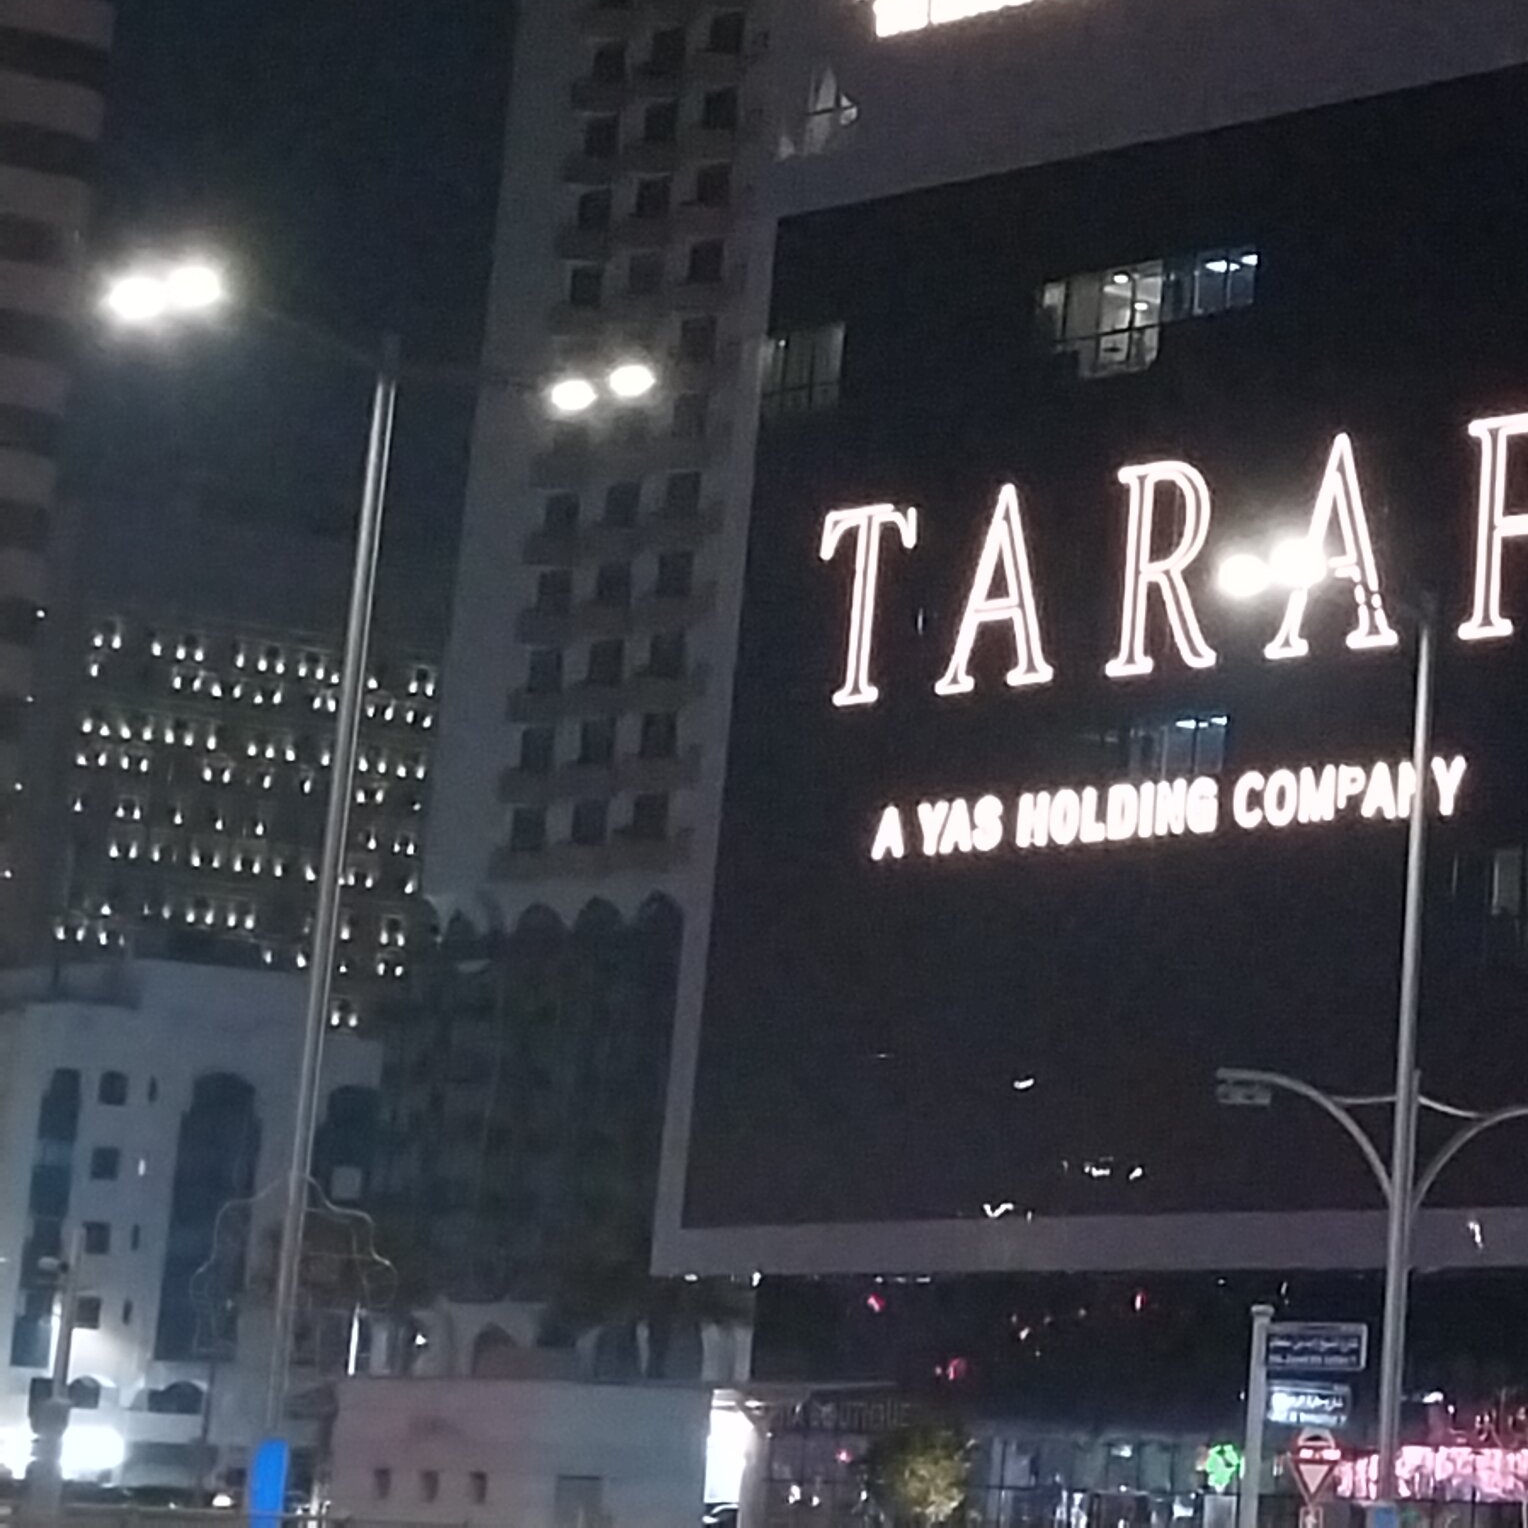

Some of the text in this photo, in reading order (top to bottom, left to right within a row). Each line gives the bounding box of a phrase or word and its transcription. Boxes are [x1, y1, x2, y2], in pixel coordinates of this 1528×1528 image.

[871, 805, 904, 860] A
[917, 795, 1002, 856] YAS
[1015, 775, 1219, 848] HOLDING
